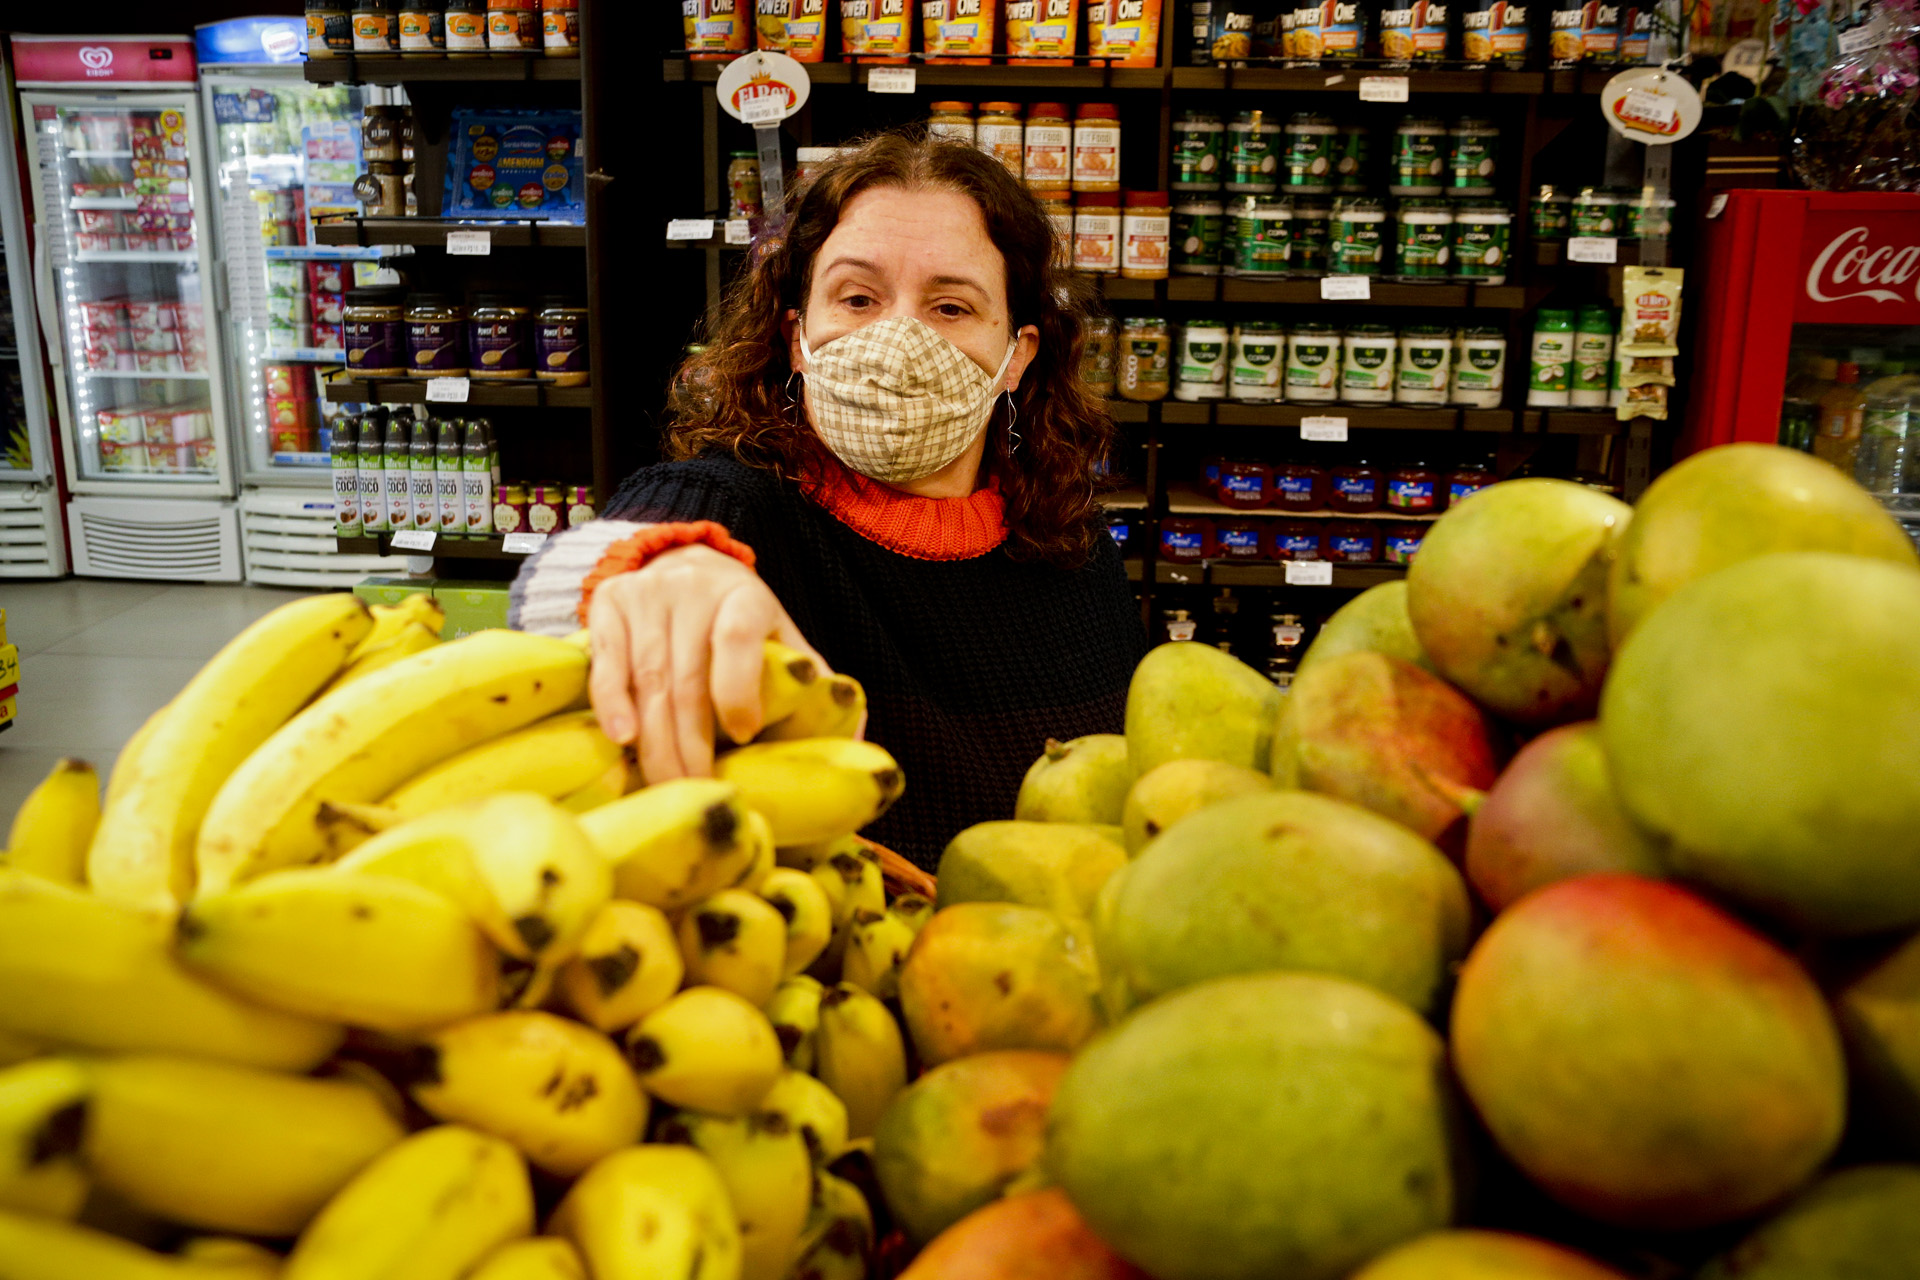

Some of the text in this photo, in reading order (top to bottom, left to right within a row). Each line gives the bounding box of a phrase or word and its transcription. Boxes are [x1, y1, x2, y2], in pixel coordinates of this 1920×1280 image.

[683, 0, 698, 16] WER
[1294, 8, 1321, 28] POWER
[1381, 9, 1412, 27] POWER
[1552, 10, 1582, 28] POWER
[1806, 226, 1920, 303] Coca
[336, 480, 357, 492] COCO
[387, 481, 407, 493] COCO
